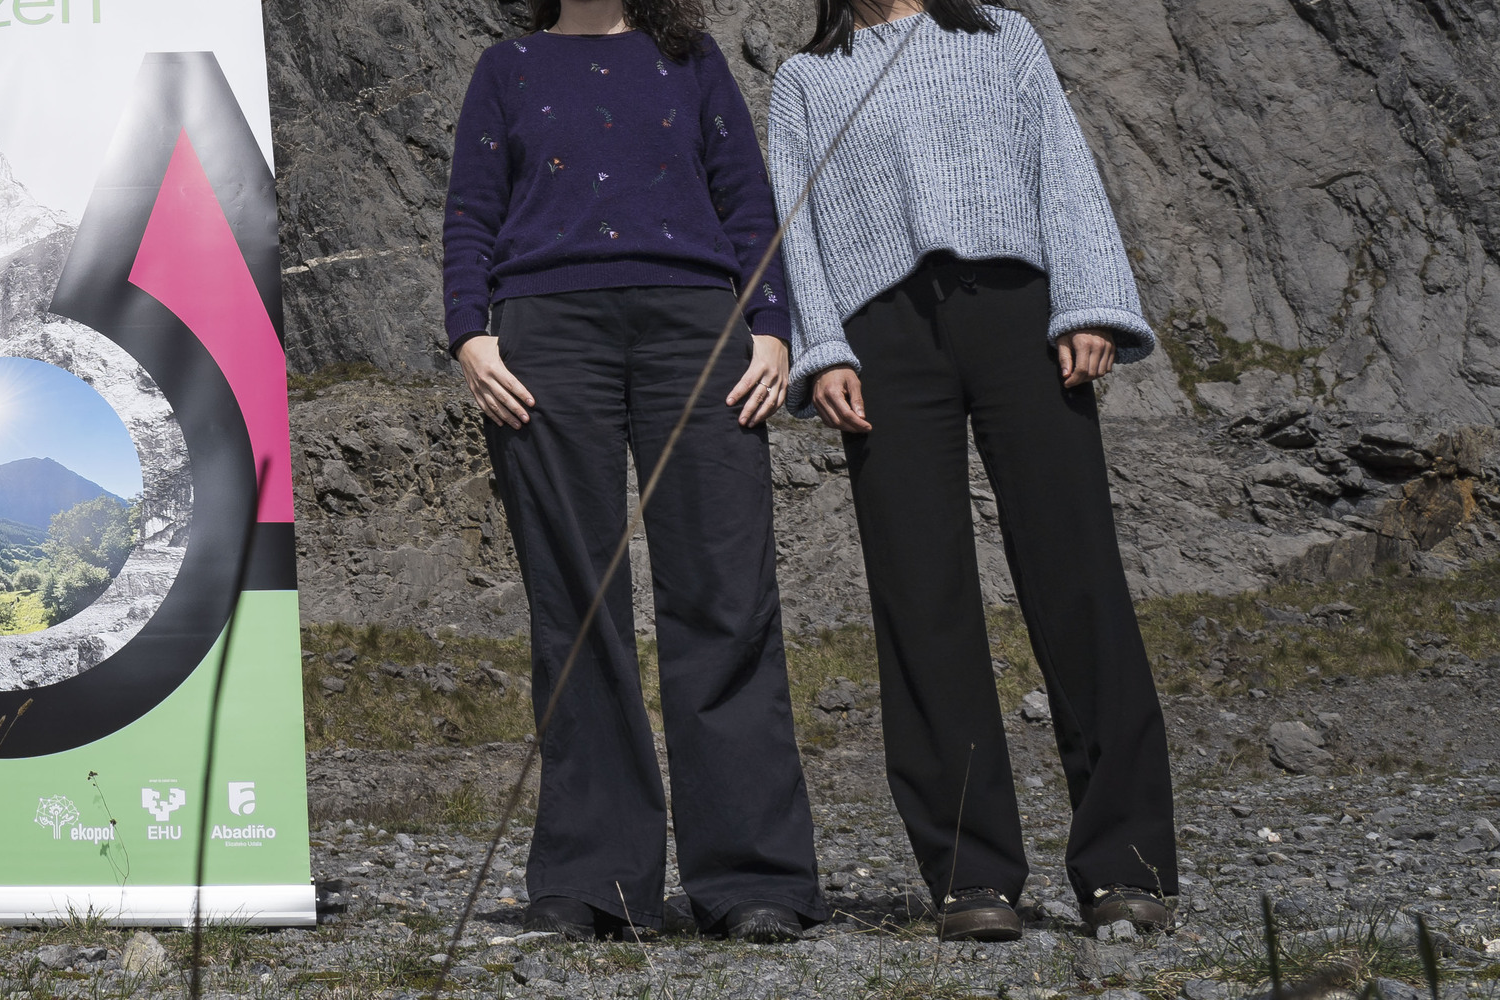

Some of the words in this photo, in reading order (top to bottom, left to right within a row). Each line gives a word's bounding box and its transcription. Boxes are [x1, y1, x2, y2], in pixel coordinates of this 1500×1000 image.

[70, 823, 115, 845] ekopol
[147, 825, 182, 840] EHU
[211, 824, 277, 839] Abadiño
